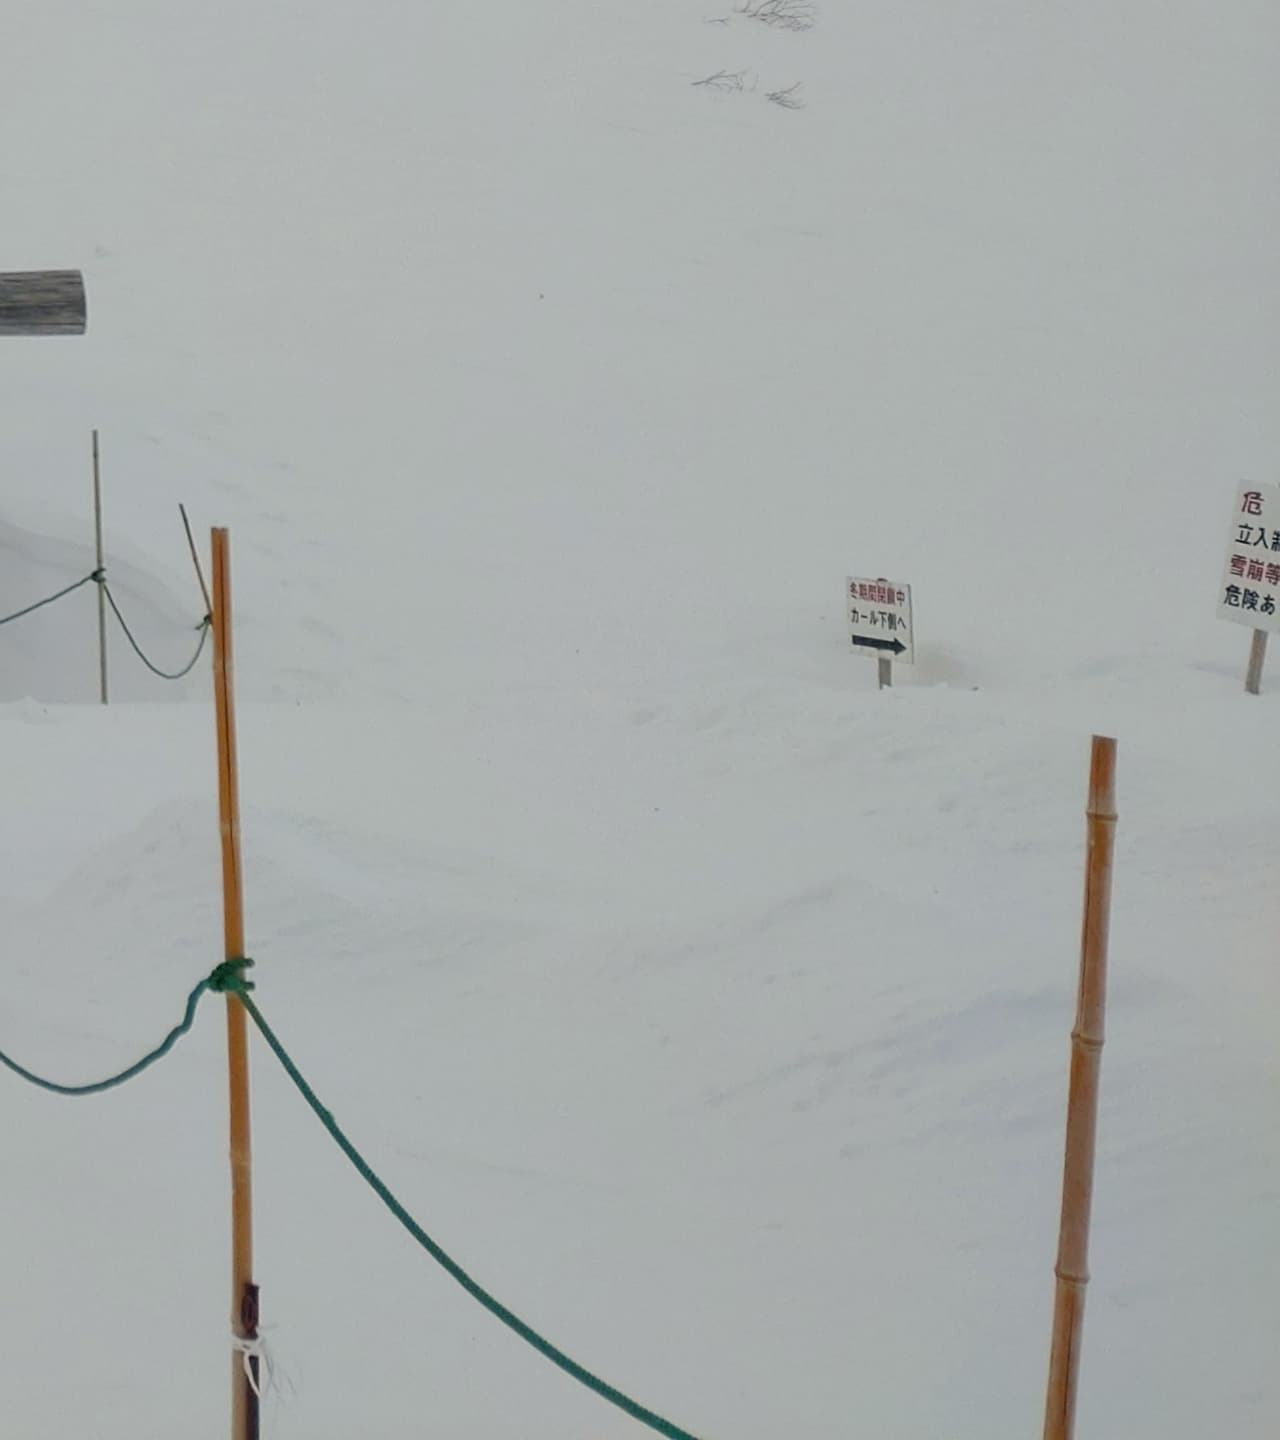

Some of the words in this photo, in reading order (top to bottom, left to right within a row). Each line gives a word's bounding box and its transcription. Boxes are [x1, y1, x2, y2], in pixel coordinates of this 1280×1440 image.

[1241, 491, 1264, 516] 危
[1224, 584, 1275, 616] 危険あ
